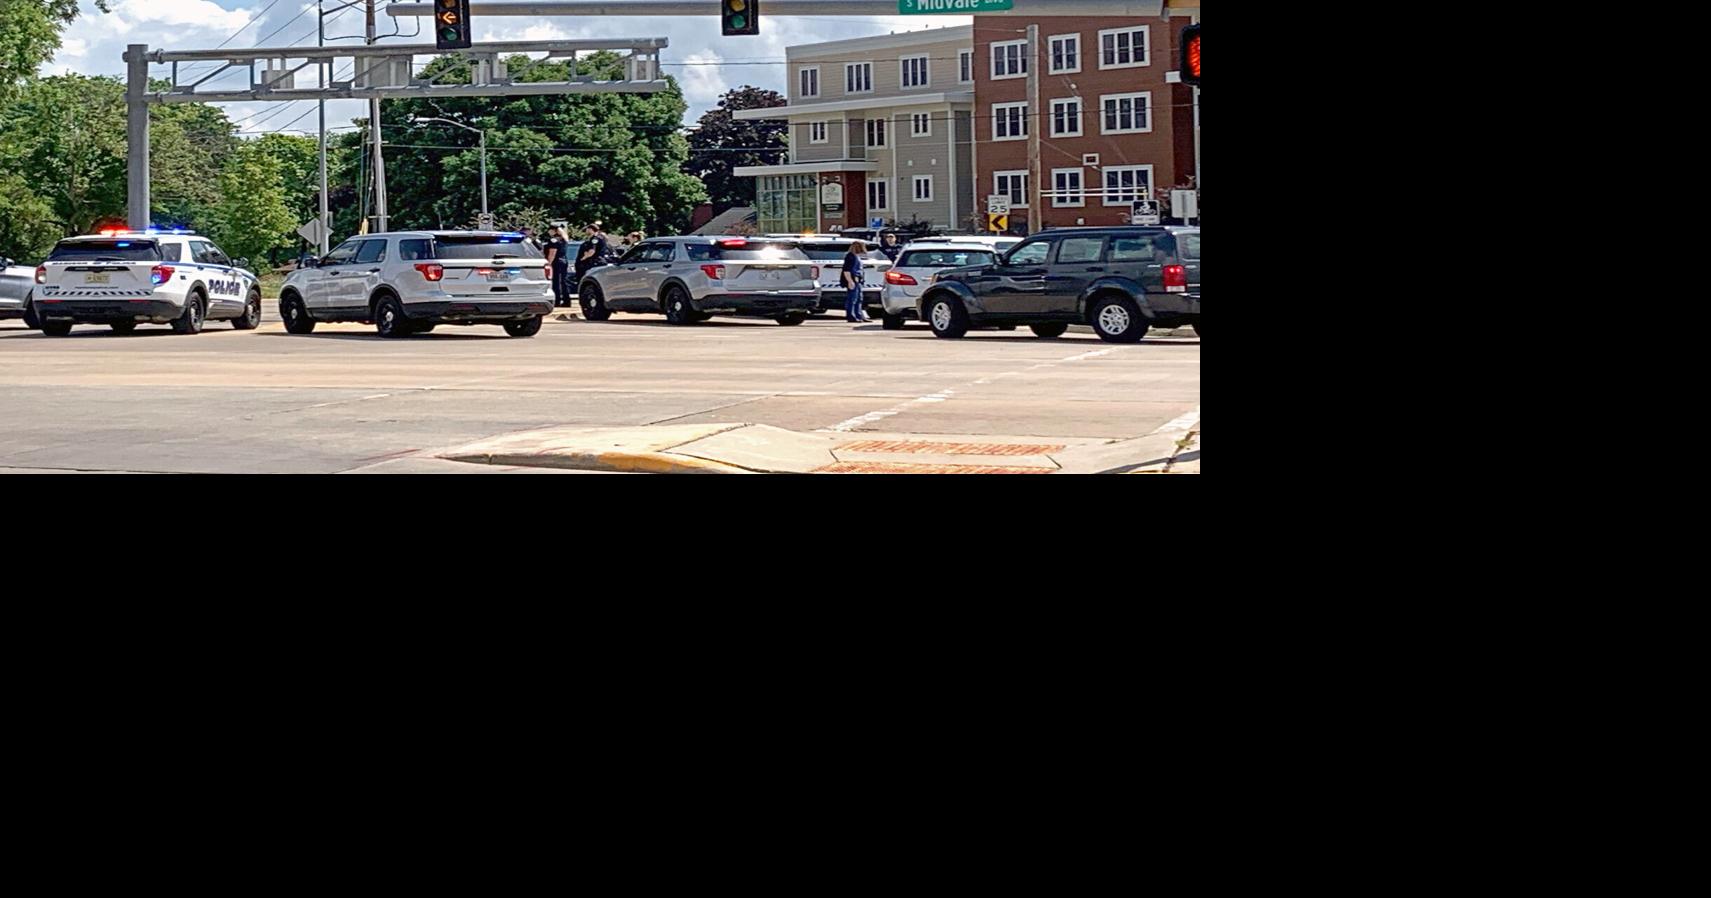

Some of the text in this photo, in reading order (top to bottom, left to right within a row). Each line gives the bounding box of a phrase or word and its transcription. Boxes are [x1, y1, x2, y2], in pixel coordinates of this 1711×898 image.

[917, 0, 979, 10] Midvale
[991, 205, 1007, 213] 25
[208, 279, 240, 296] POLICE
